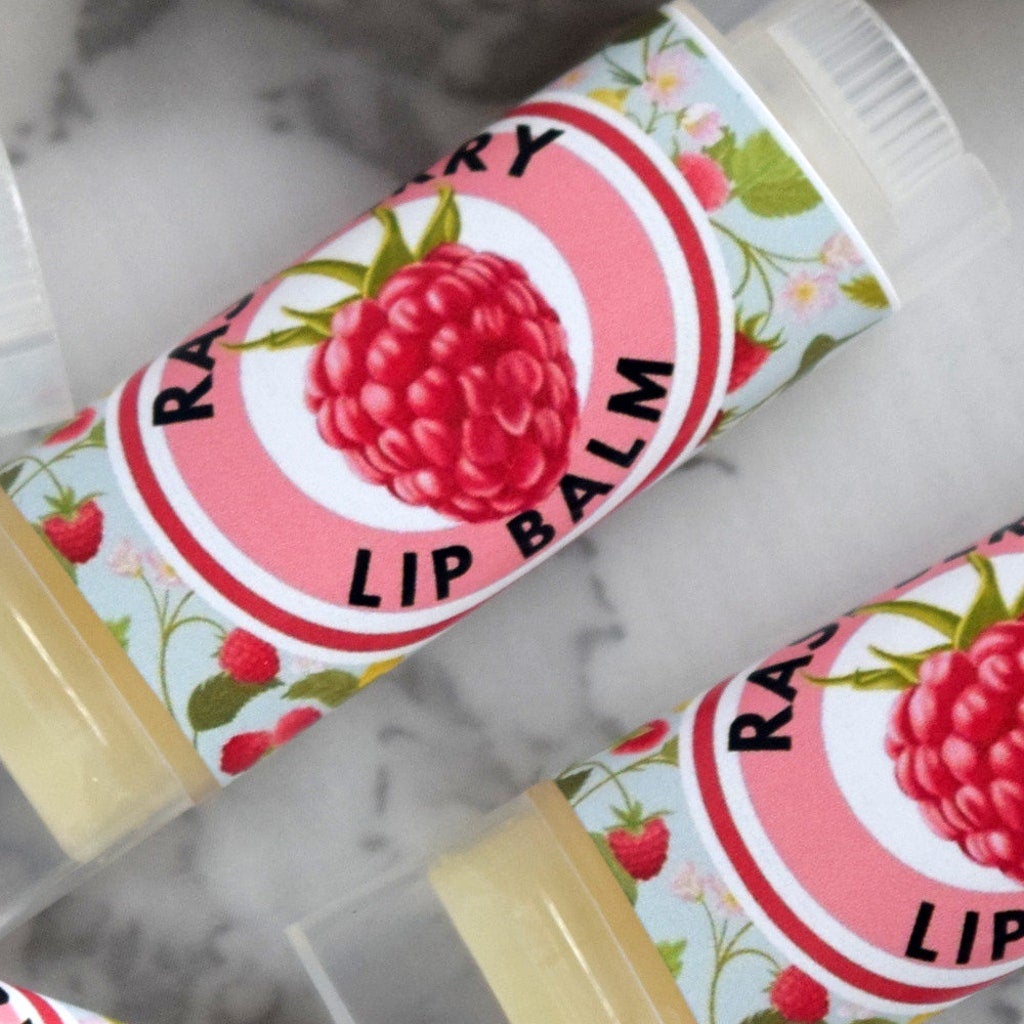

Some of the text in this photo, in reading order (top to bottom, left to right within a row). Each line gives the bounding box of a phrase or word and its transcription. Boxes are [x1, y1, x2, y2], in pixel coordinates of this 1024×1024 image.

[348, 357, 675, 608] LIP BALM
[905, 901, 1024, 965] LIP
